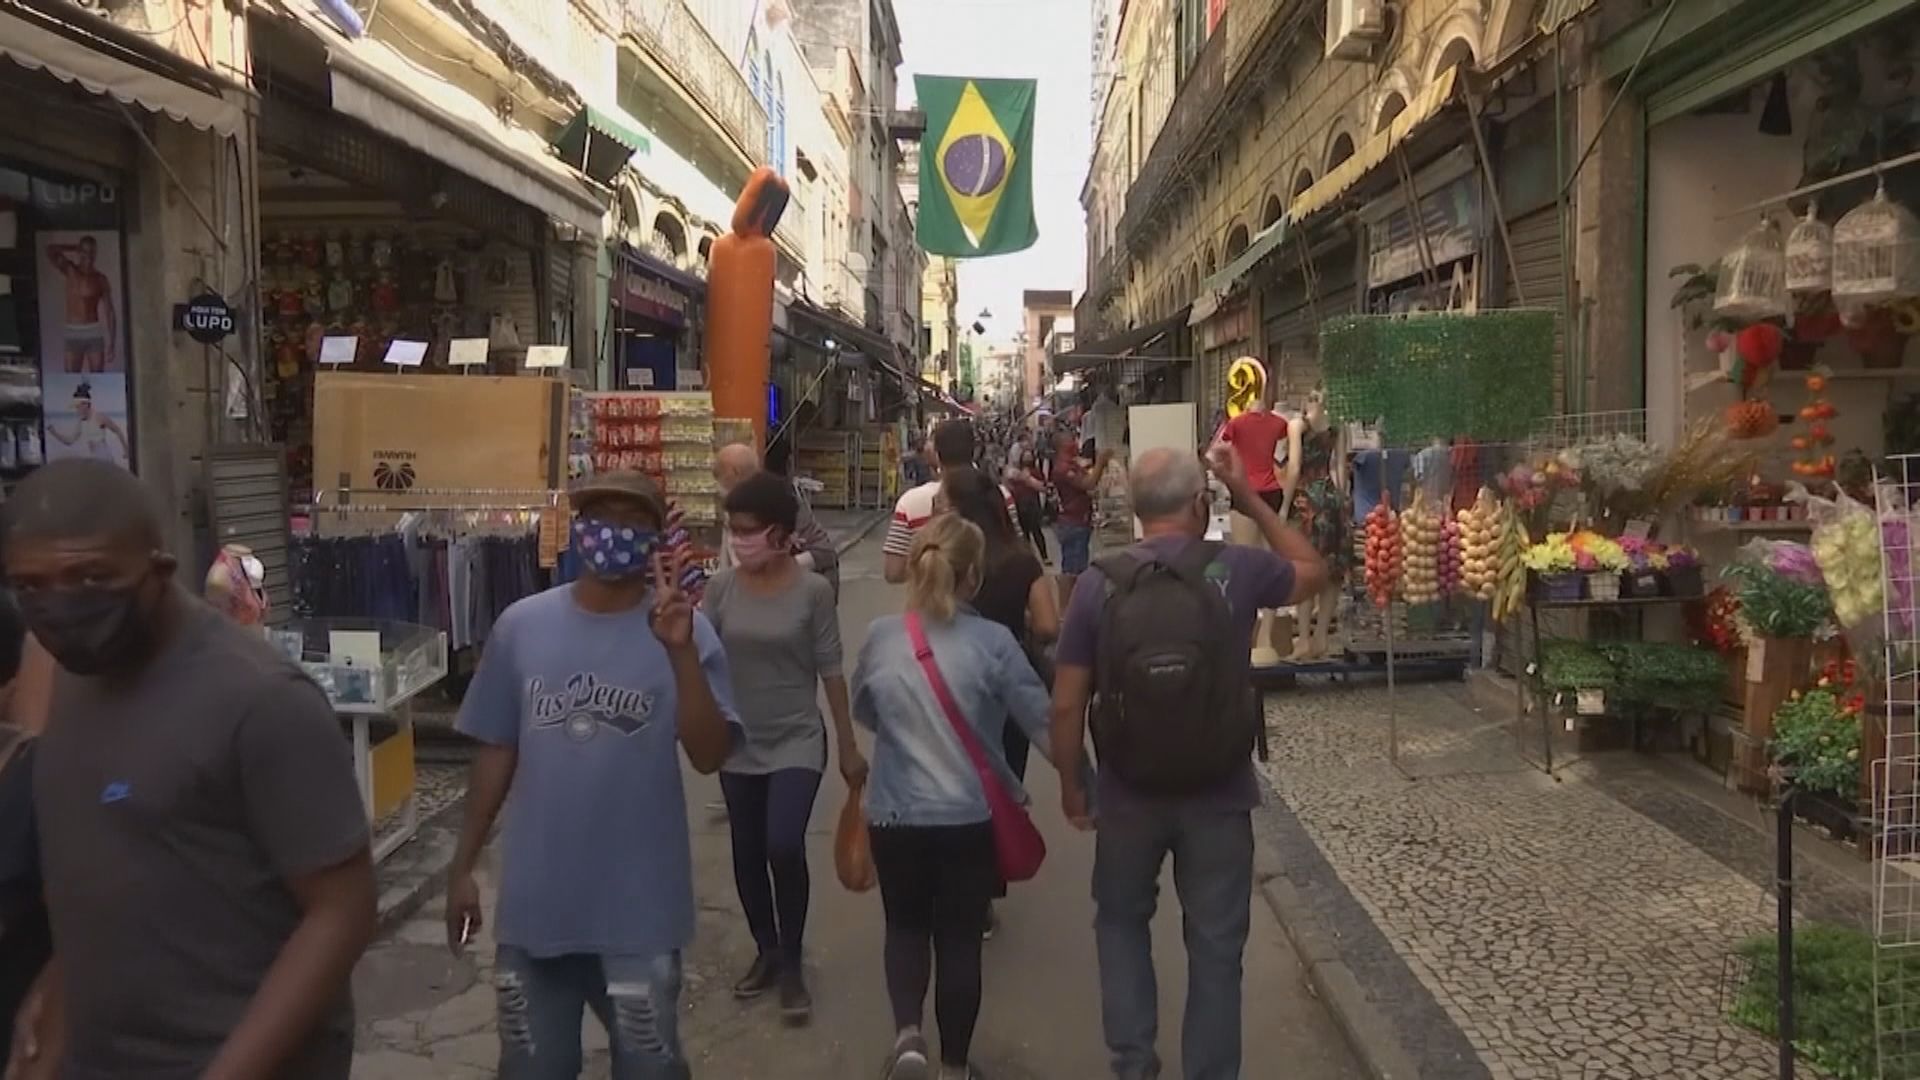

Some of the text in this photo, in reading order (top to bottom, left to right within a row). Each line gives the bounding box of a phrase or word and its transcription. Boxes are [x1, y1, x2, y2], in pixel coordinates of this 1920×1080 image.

[182, 313, 232, 330] LUPO
[529, 671, 655, 719] Las Vegas
